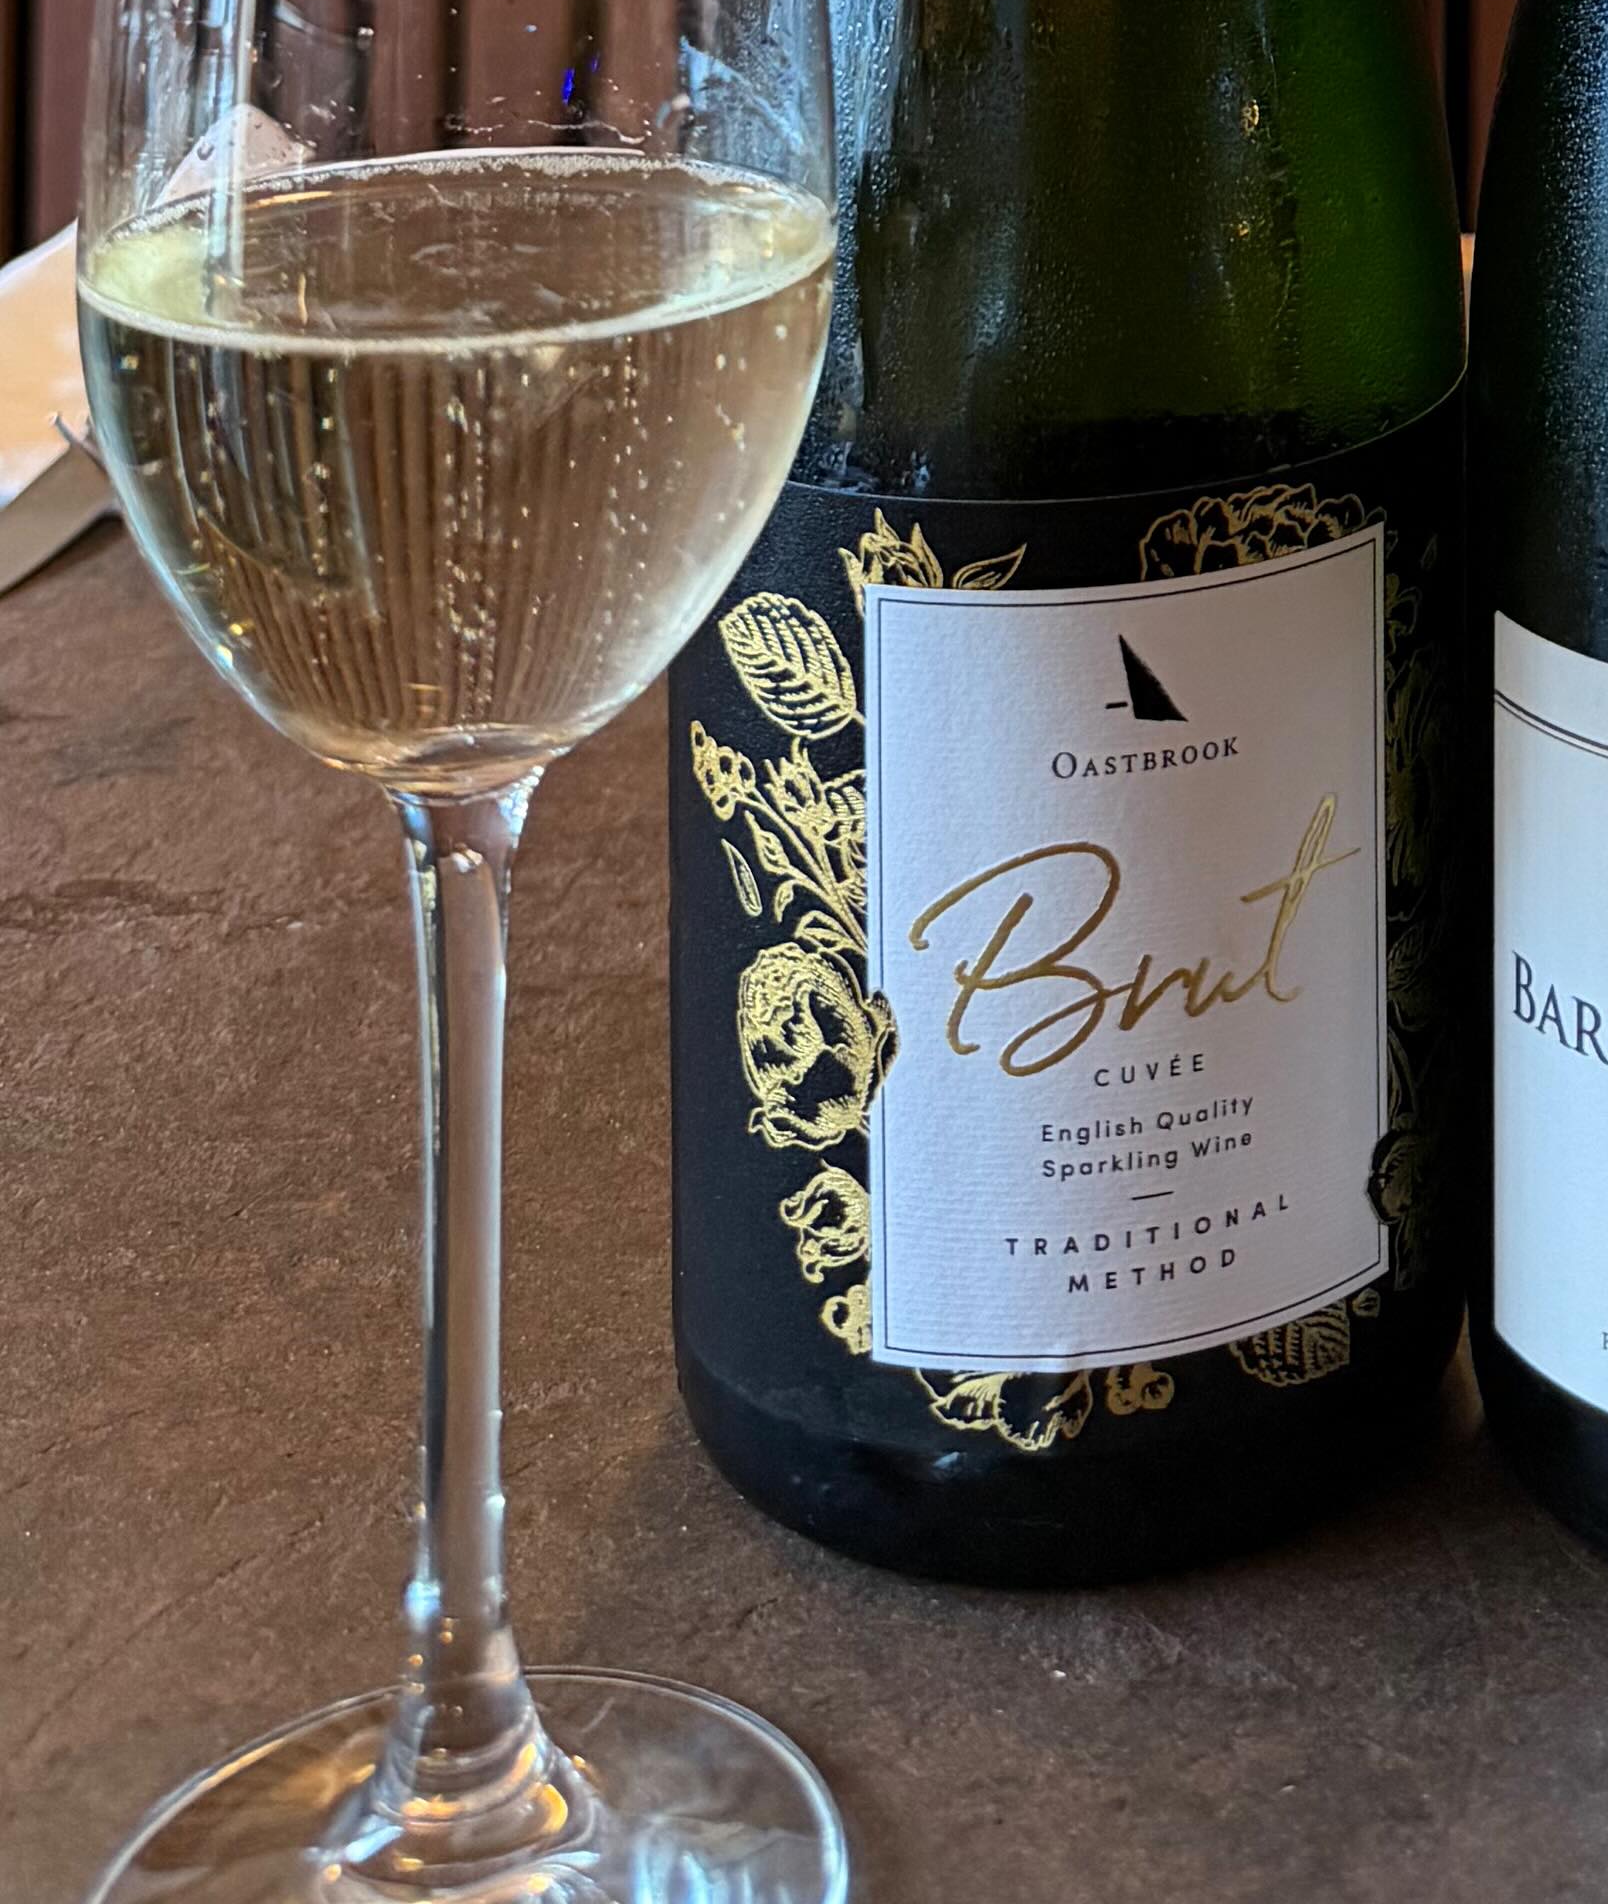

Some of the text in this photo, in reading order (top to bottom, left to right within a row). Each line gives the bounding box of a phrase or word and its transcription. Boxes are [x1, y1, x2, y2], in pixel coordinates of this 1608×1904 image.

[1051, 736, 1240, 780] OASTBROOK
[908, 793, 1362, 1078] Brut
[1093, 1054, 1206, 1087] CUVÉE
[1041, 1096, 1254, 1145] English Quality
[1041, 1130, 1253, 1182] Sparkling Wine
[1005, 1194, 1290, 1256] TRADITIONAL
[1068, 1248, 1237, 1293] METHOD
